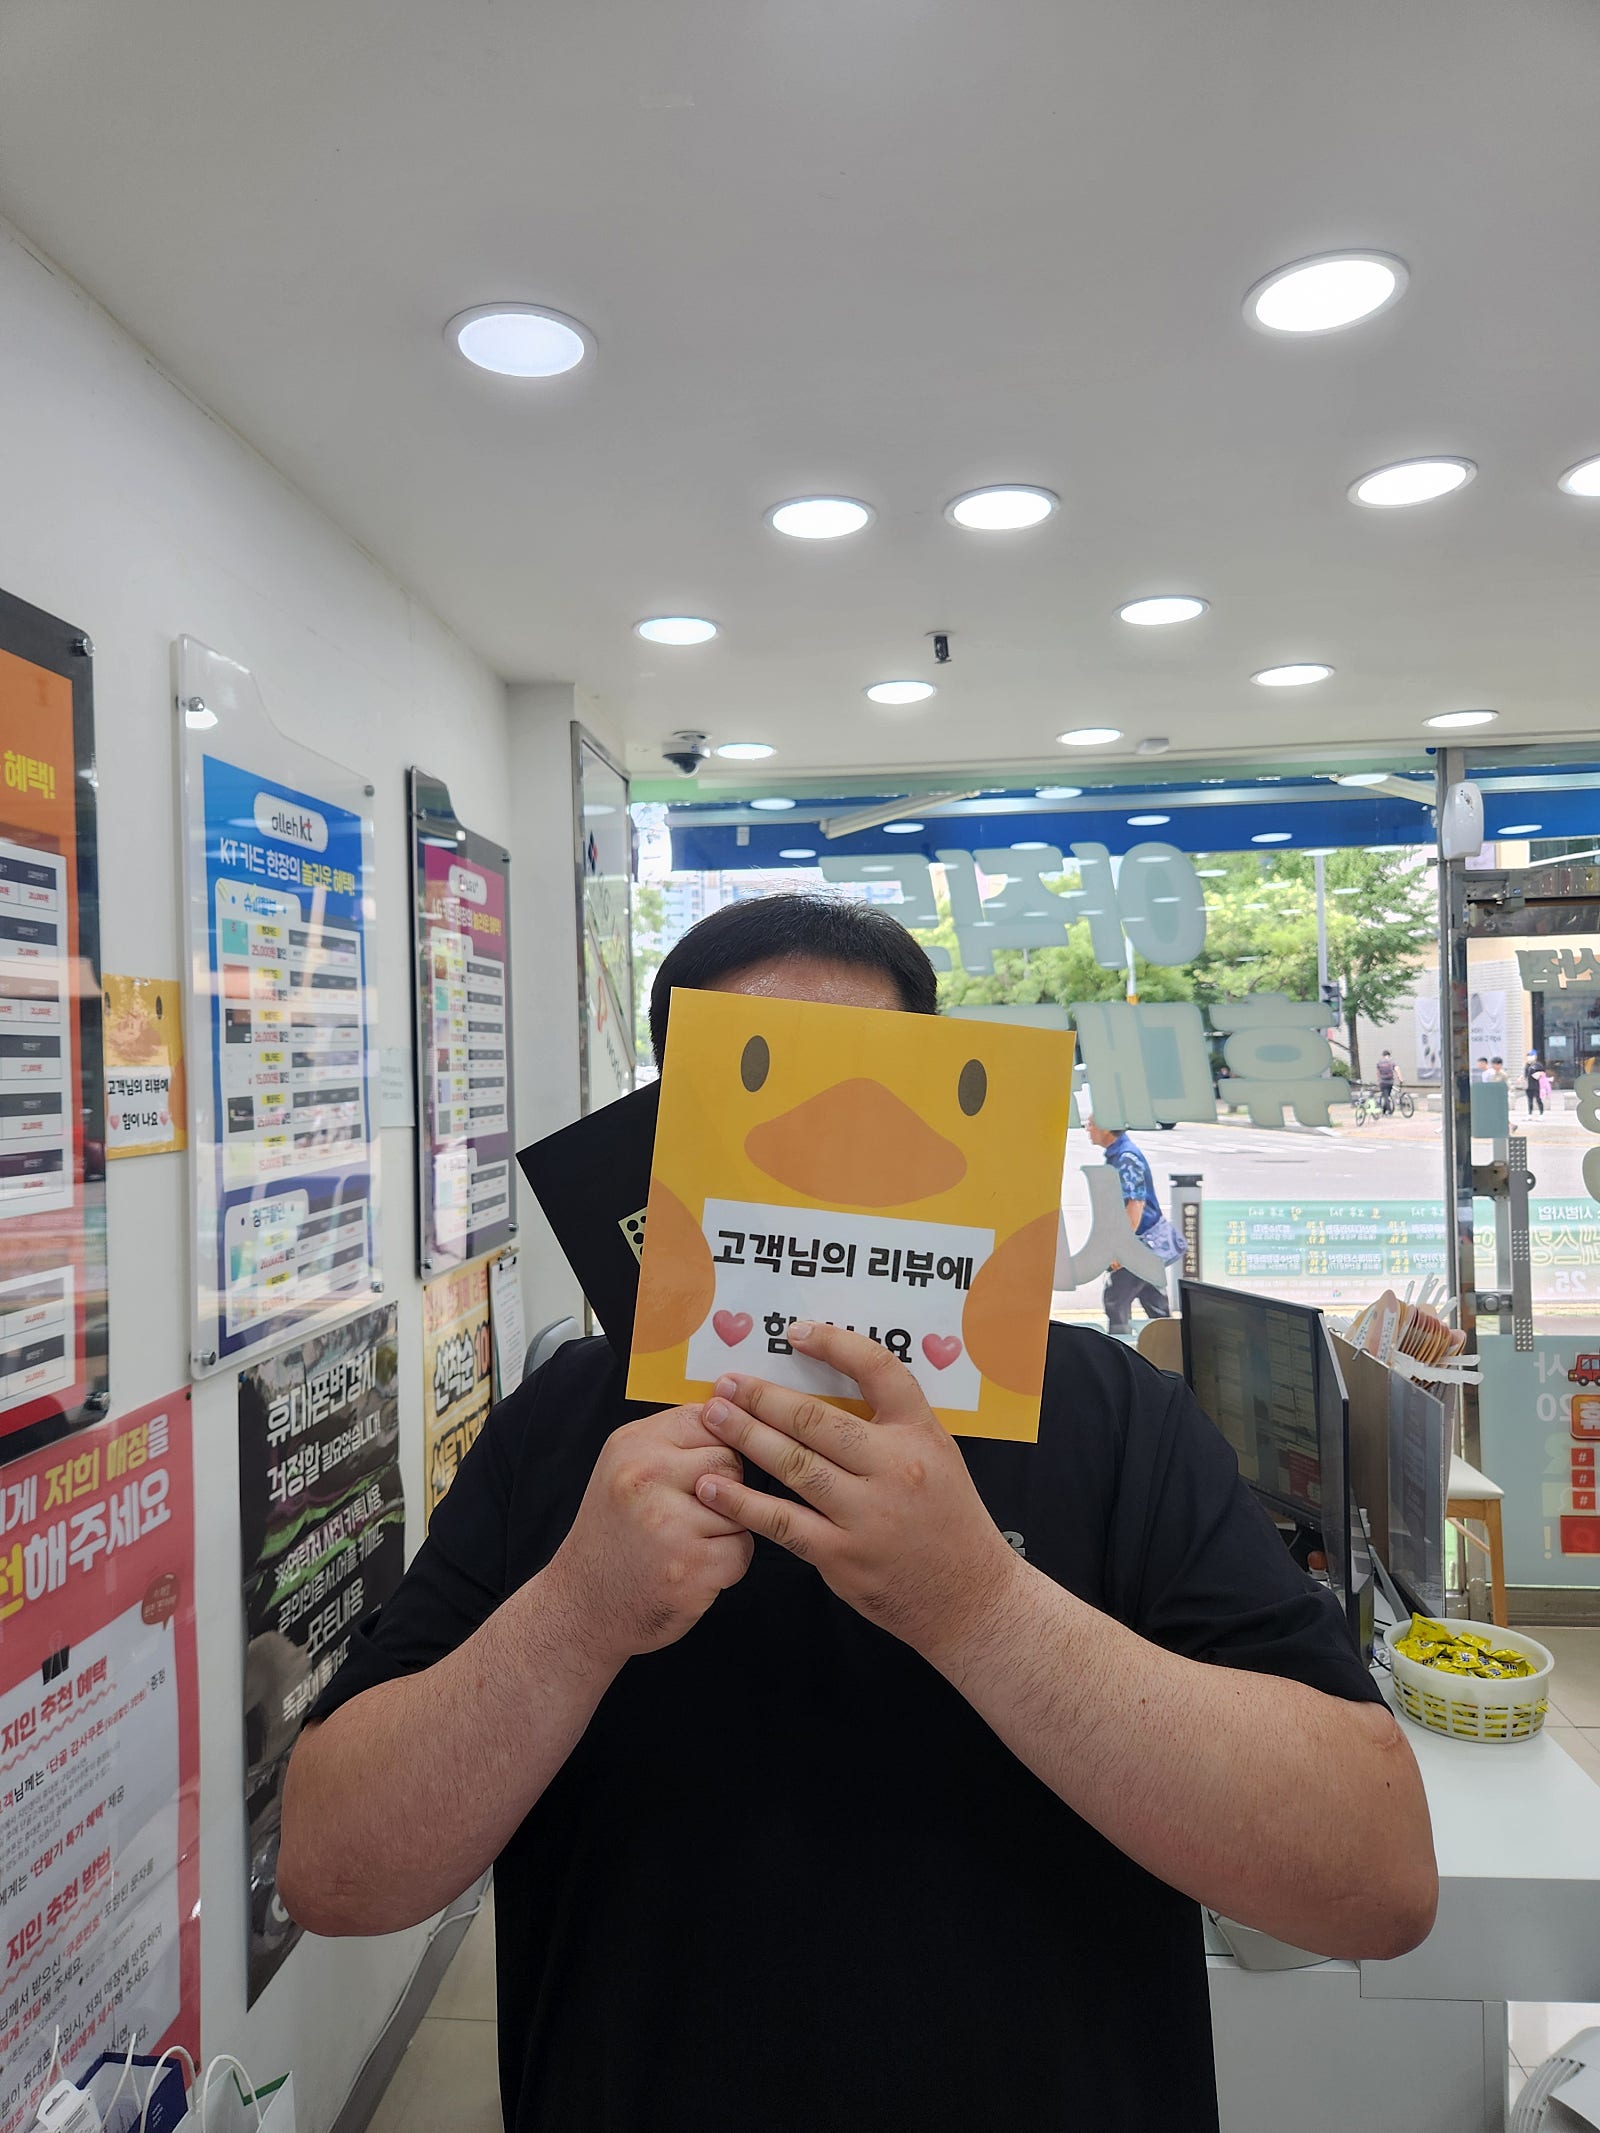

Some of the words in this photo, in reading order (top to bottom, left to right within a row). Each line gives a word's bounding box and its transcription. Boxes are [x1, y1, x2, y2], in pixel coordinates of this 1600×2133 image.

[4, 750, 56, 800] 혜택!
[271, 812, 298, 836] olleh
[299, 815, 313, 842] kt
[266, 849, 301, 884] 한장의
[302, 860, 332, 891] 놀라운
[333, 868, 356, 896] 혜택!
[107, 1078, 142, 1096] 고객님의
[145, 1078, 169, 1093] 리뷰에
[122, 1112, 140, 1130] 힘이
[142, 1111, 158, 1126] 나요
[713, 1230, 857, 1278] 고객님의
[868, 1246, 974, 1290] 리뷰에
[267, 1345, 377, 1447] 휴대폰변경시
[433, 1327, 475, 1418] 선착순
[44, 1447, 99, 1511] 저희
[107, 1413, 170, 1482] 매장을
[267, 1441, 322, 1502] 걱정할
[322, 1409, 381, 1473] 필요없습니다!
[308, 1577, 364, 1658] 모든내용
[1, 1706, 37, 1755] 지인
[41, 1680, 73, 1722] 추천
[77, 1656, 108, 1698] 혜택
[107, 1785, 125, 1809] 제공
[7, 1912, 42, 1968] 지인
[47, 1878, 78, 1925] 추천
[82, 1846, 111, 1894] 방법
[31, 1954, 61, 1995] 받으신
[85, 1988, 102, 2018] 저희
[103, 1958, 129, 1994] 매장에
